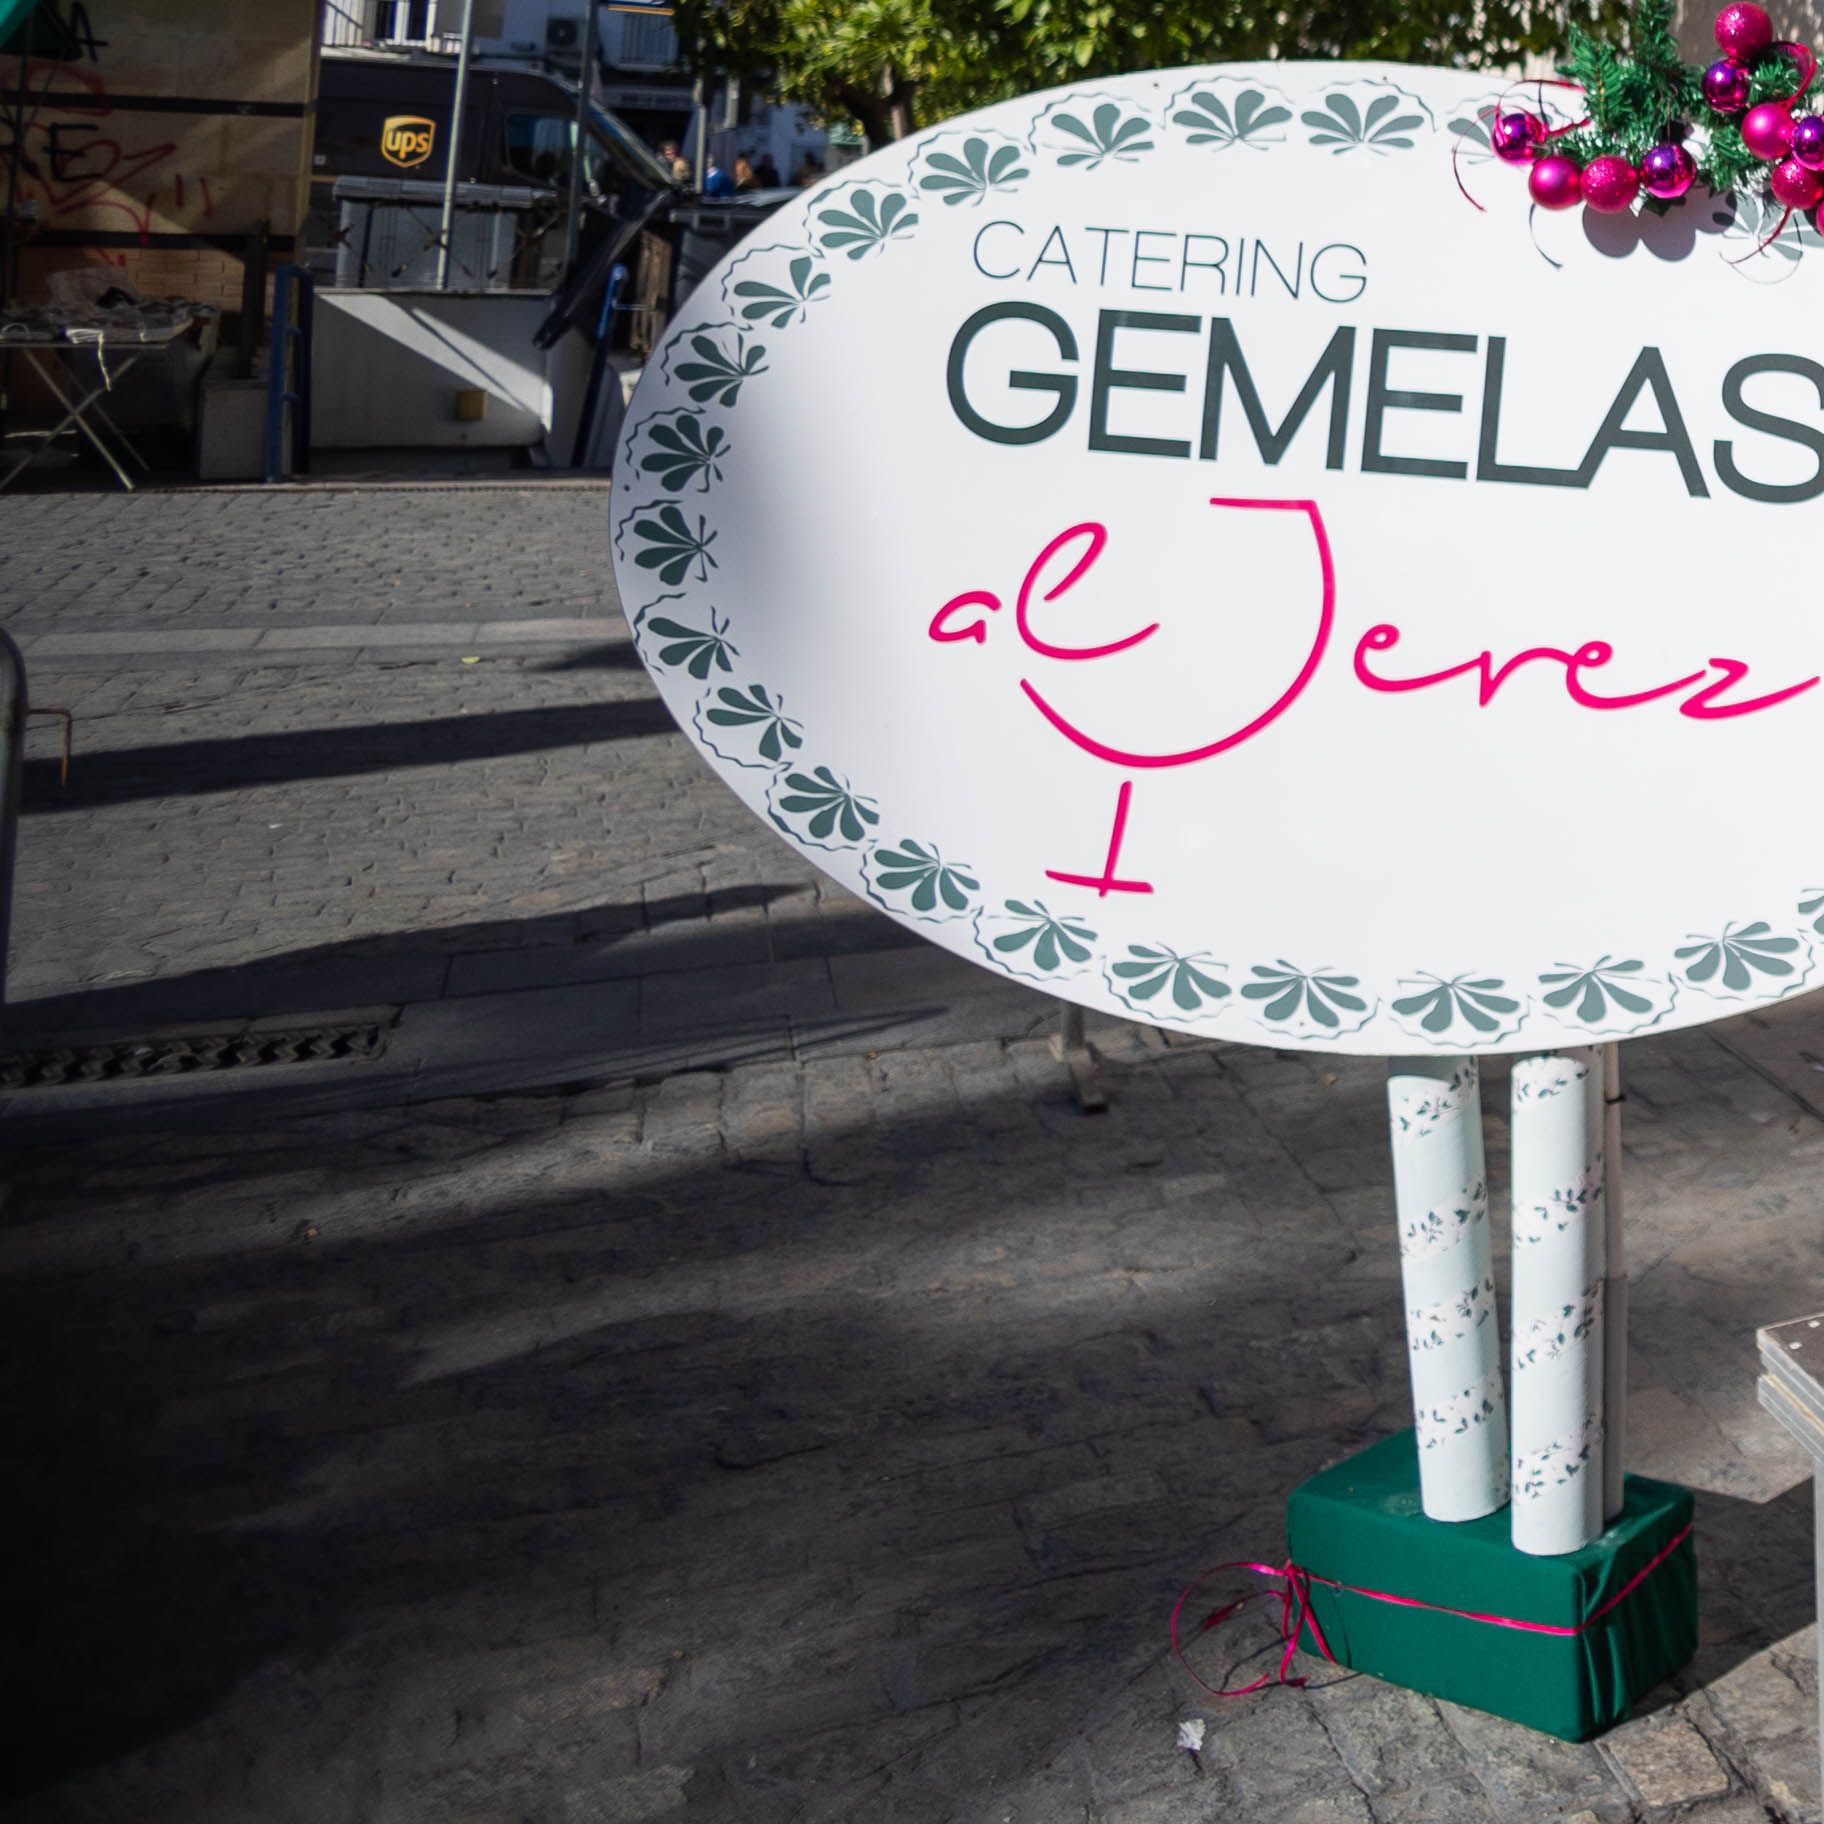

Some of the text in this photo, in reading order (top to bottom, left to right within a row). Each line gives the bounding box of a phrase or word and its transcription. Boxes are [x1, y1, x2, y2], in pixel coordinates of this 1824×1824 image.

[386, 129, 429, 159] ups
[973, 220, 1368, 304] CATERING
[1019, 497, 1821, 770] Jerez
